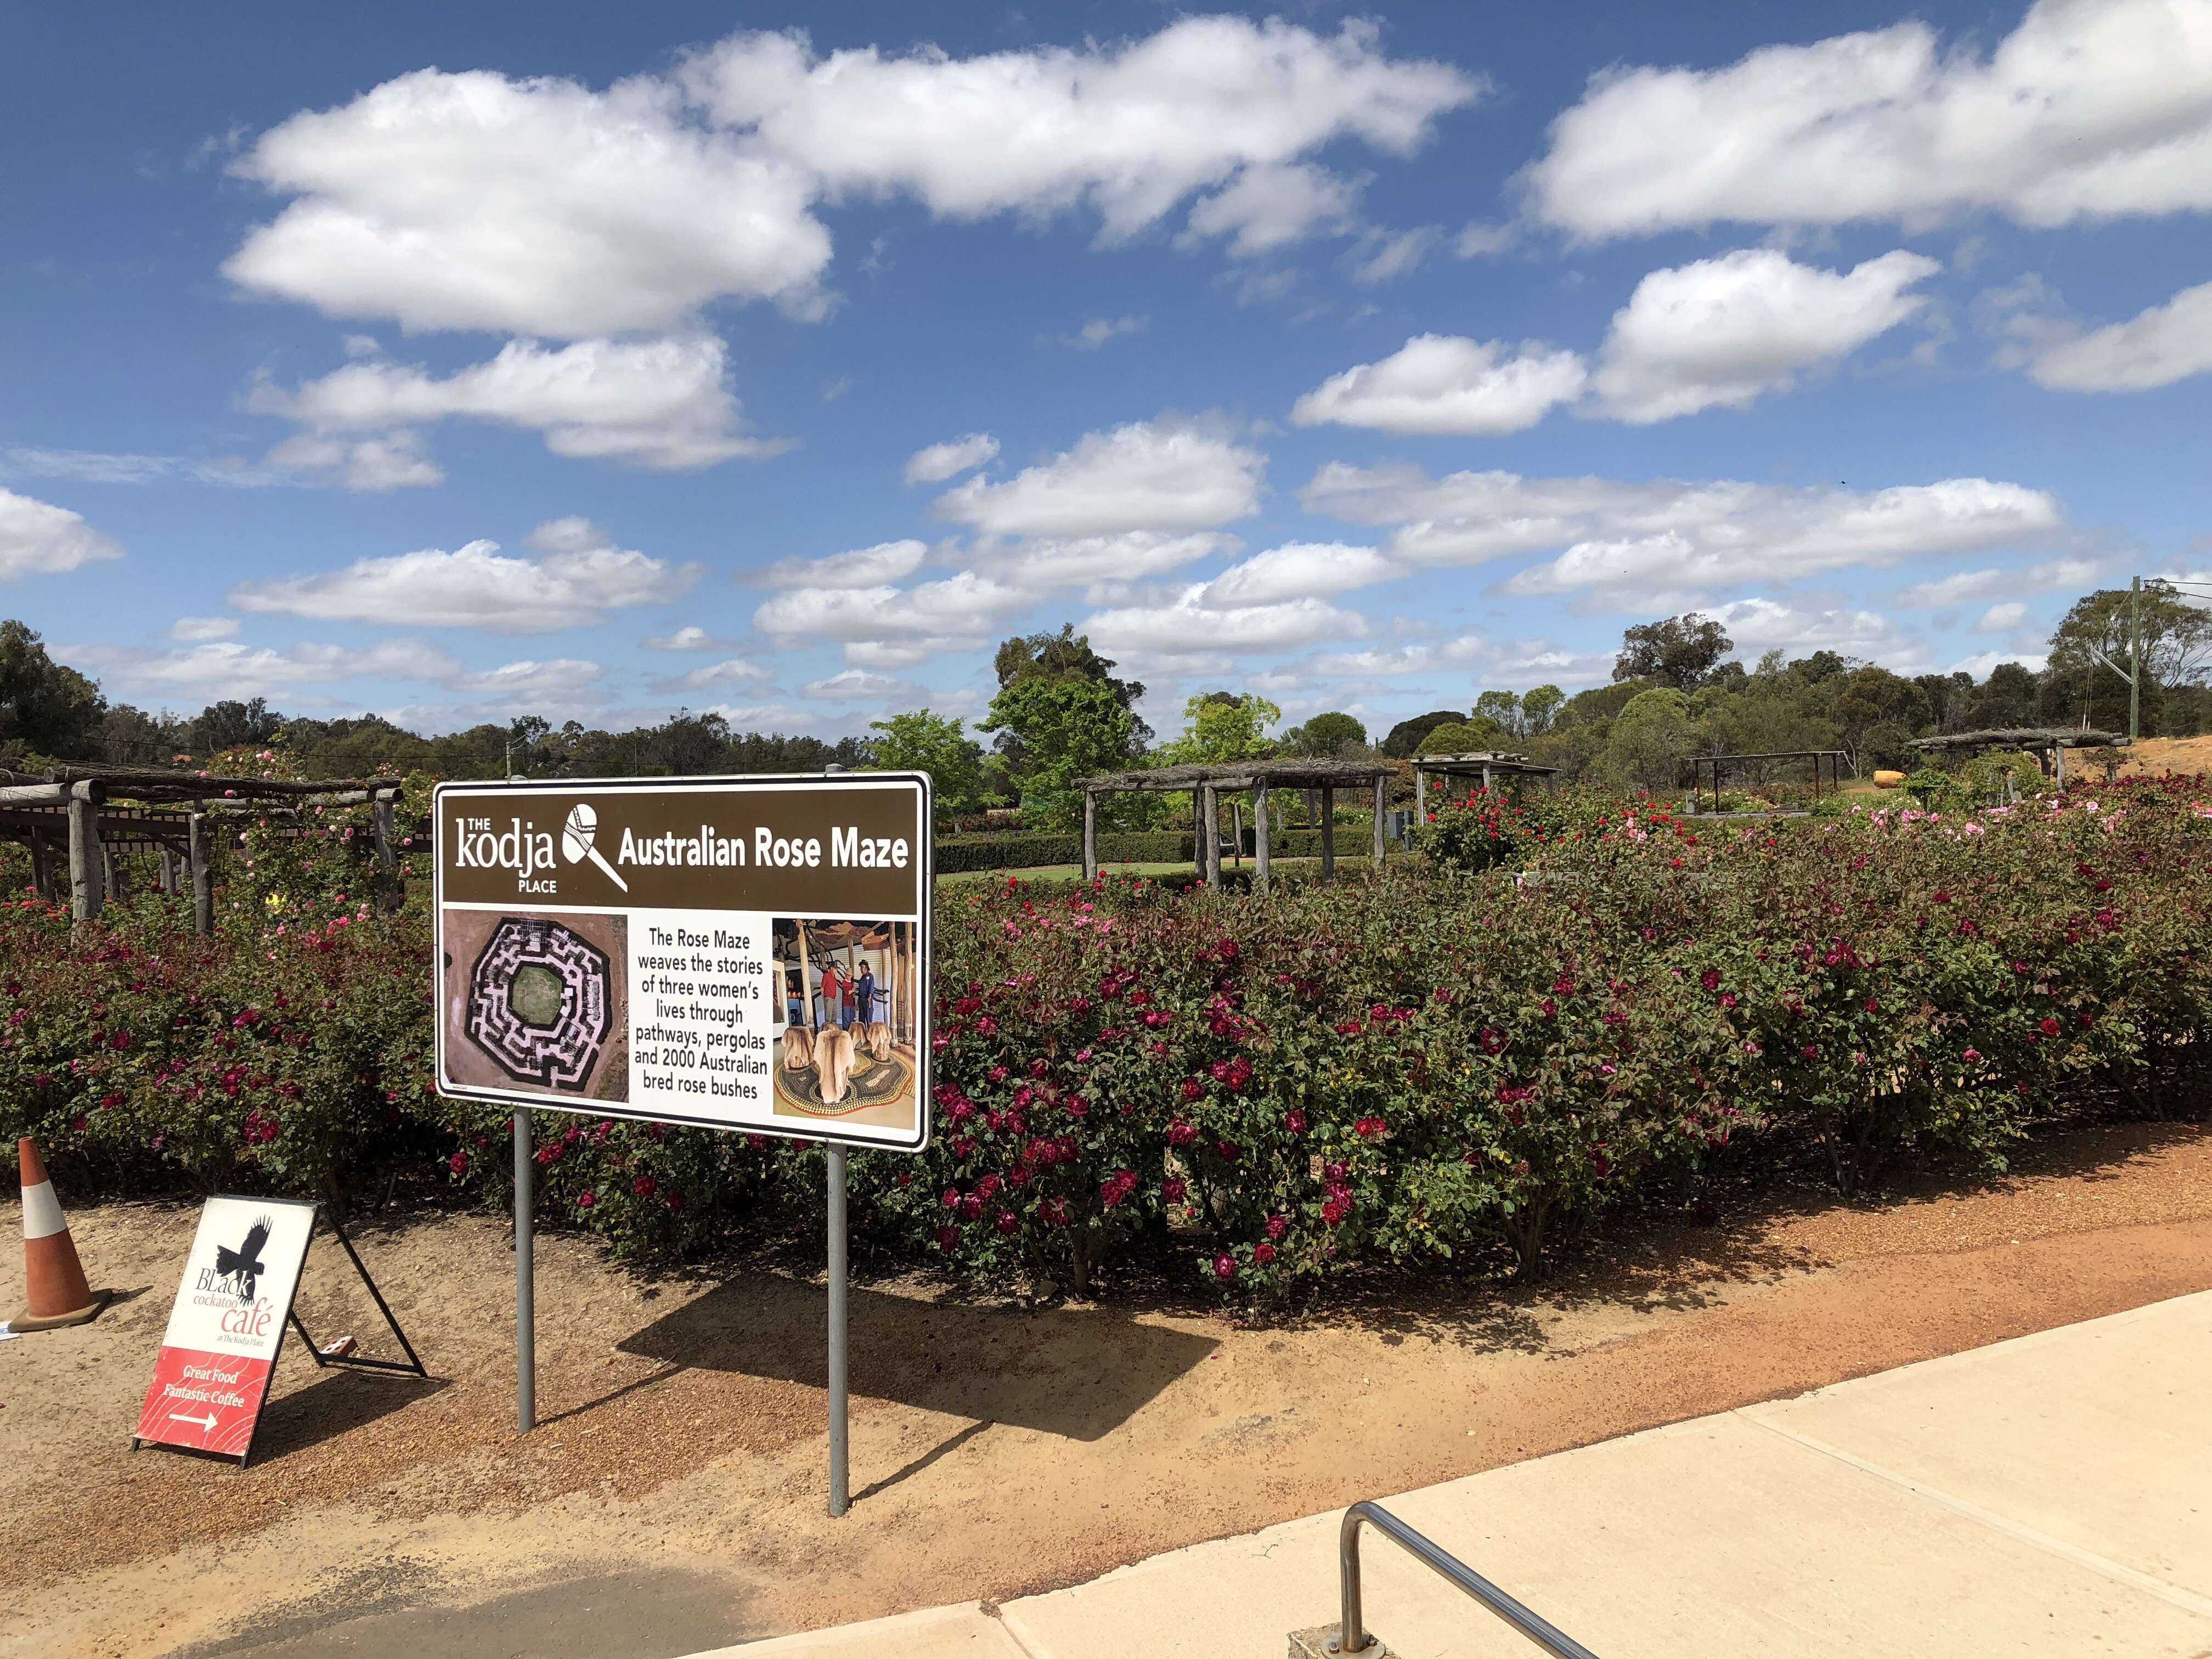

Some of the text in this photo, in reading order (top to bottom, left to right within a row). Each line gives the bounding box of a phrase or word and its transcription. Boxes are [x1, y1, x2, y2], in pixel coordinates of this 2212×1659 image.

[467, 818, 490, 831] THE
[455, 818, 556, 878] kodja
[618, 825, 909, 868] Australian Rose Maze
[518, 880, 557, 893] PLACE
[649, 927, 750, 949] The Rose Maze
[638, 952, 763, 974] weaves the stories
[642, 974, 655, 993] of
[659, 975, 693, 995] three
[657, 998, 743, 1028] lives through
[636, 1023, 765, 1053] pathways, pergolas
[635, 1046, 768, 1075] and 2000 Australian
[644, 1069, 757, 1099] bred rose bushes
[193, 1294, 238, 1308] cockatoo
[221, 1297, 273, 1336] café
[234, 1336, 249, 1346] Kodja
[250, 1338, 264, 1346] Place
[183, 1364, 239, 1385] Great Food
[163, 1384, 245, 1407] Fantastic Coffee
